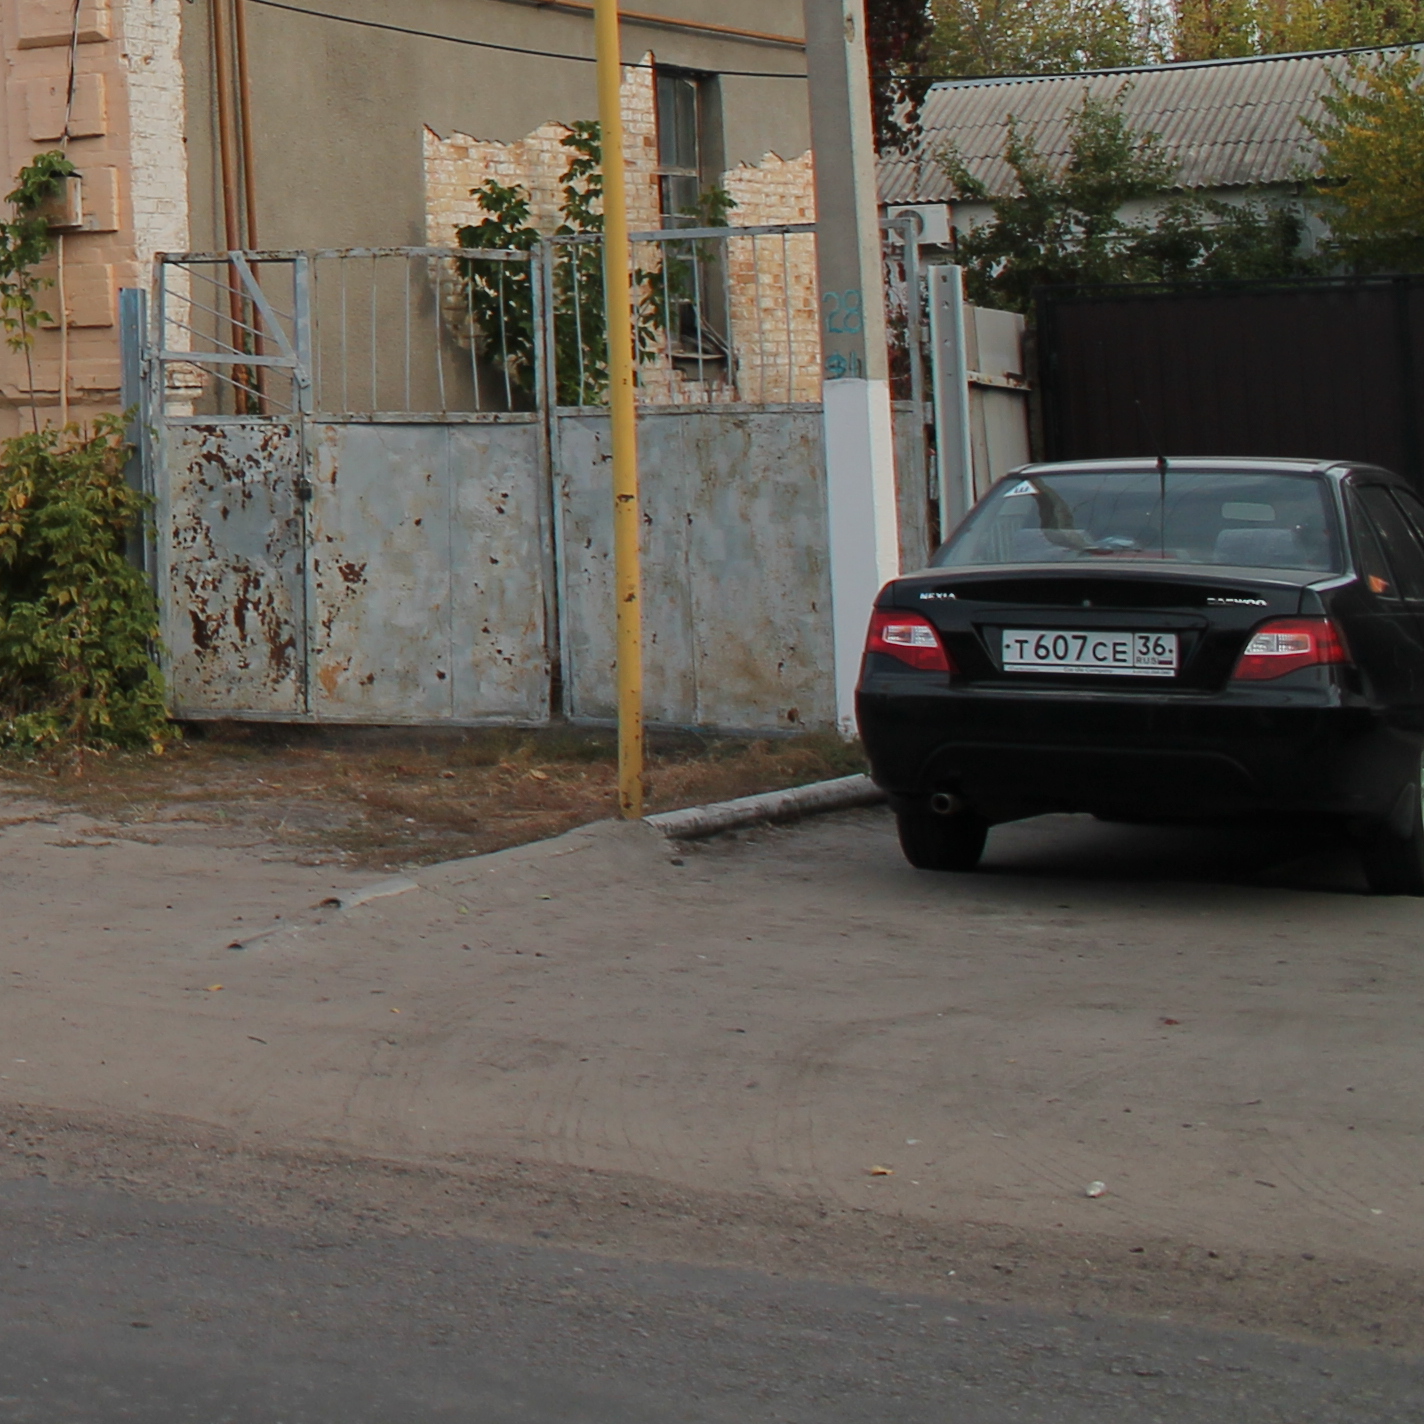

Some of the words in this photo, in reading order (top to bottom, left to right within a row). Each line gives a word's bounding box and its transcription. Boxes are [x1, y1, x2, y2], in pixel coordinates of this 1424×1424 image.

[823, 289, 864, 334] 28
[1137, 635, 1166, 656] 36
[1136, 656, 1158, 664] RUS
